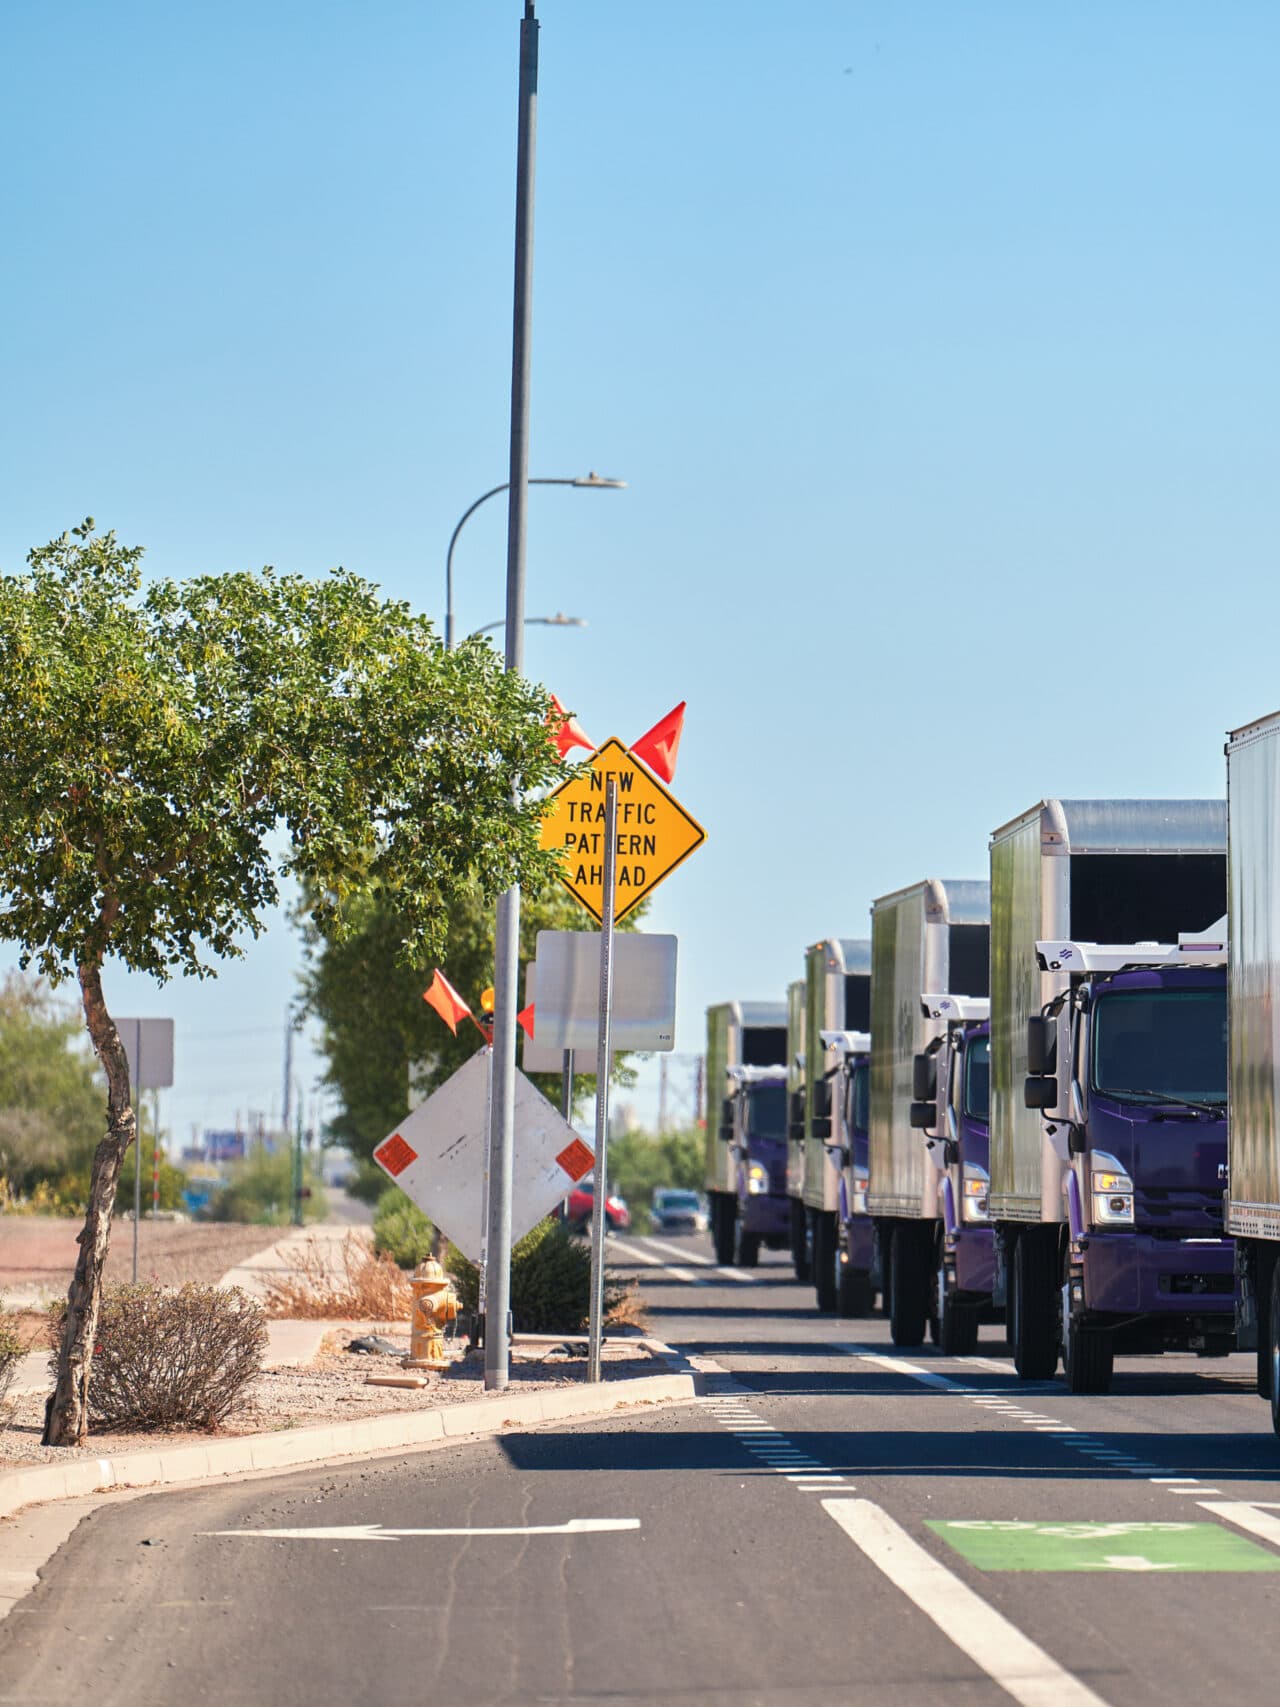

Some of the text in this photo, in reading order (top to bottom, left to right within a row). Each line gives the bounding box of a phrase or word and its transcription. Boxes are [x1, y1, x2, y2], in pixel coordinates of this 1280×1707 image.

[567, 802, 656, 825] TRAFIC
[565, 832, 656, 856] PATERN
[575, 864, 646, 887] AHAD
